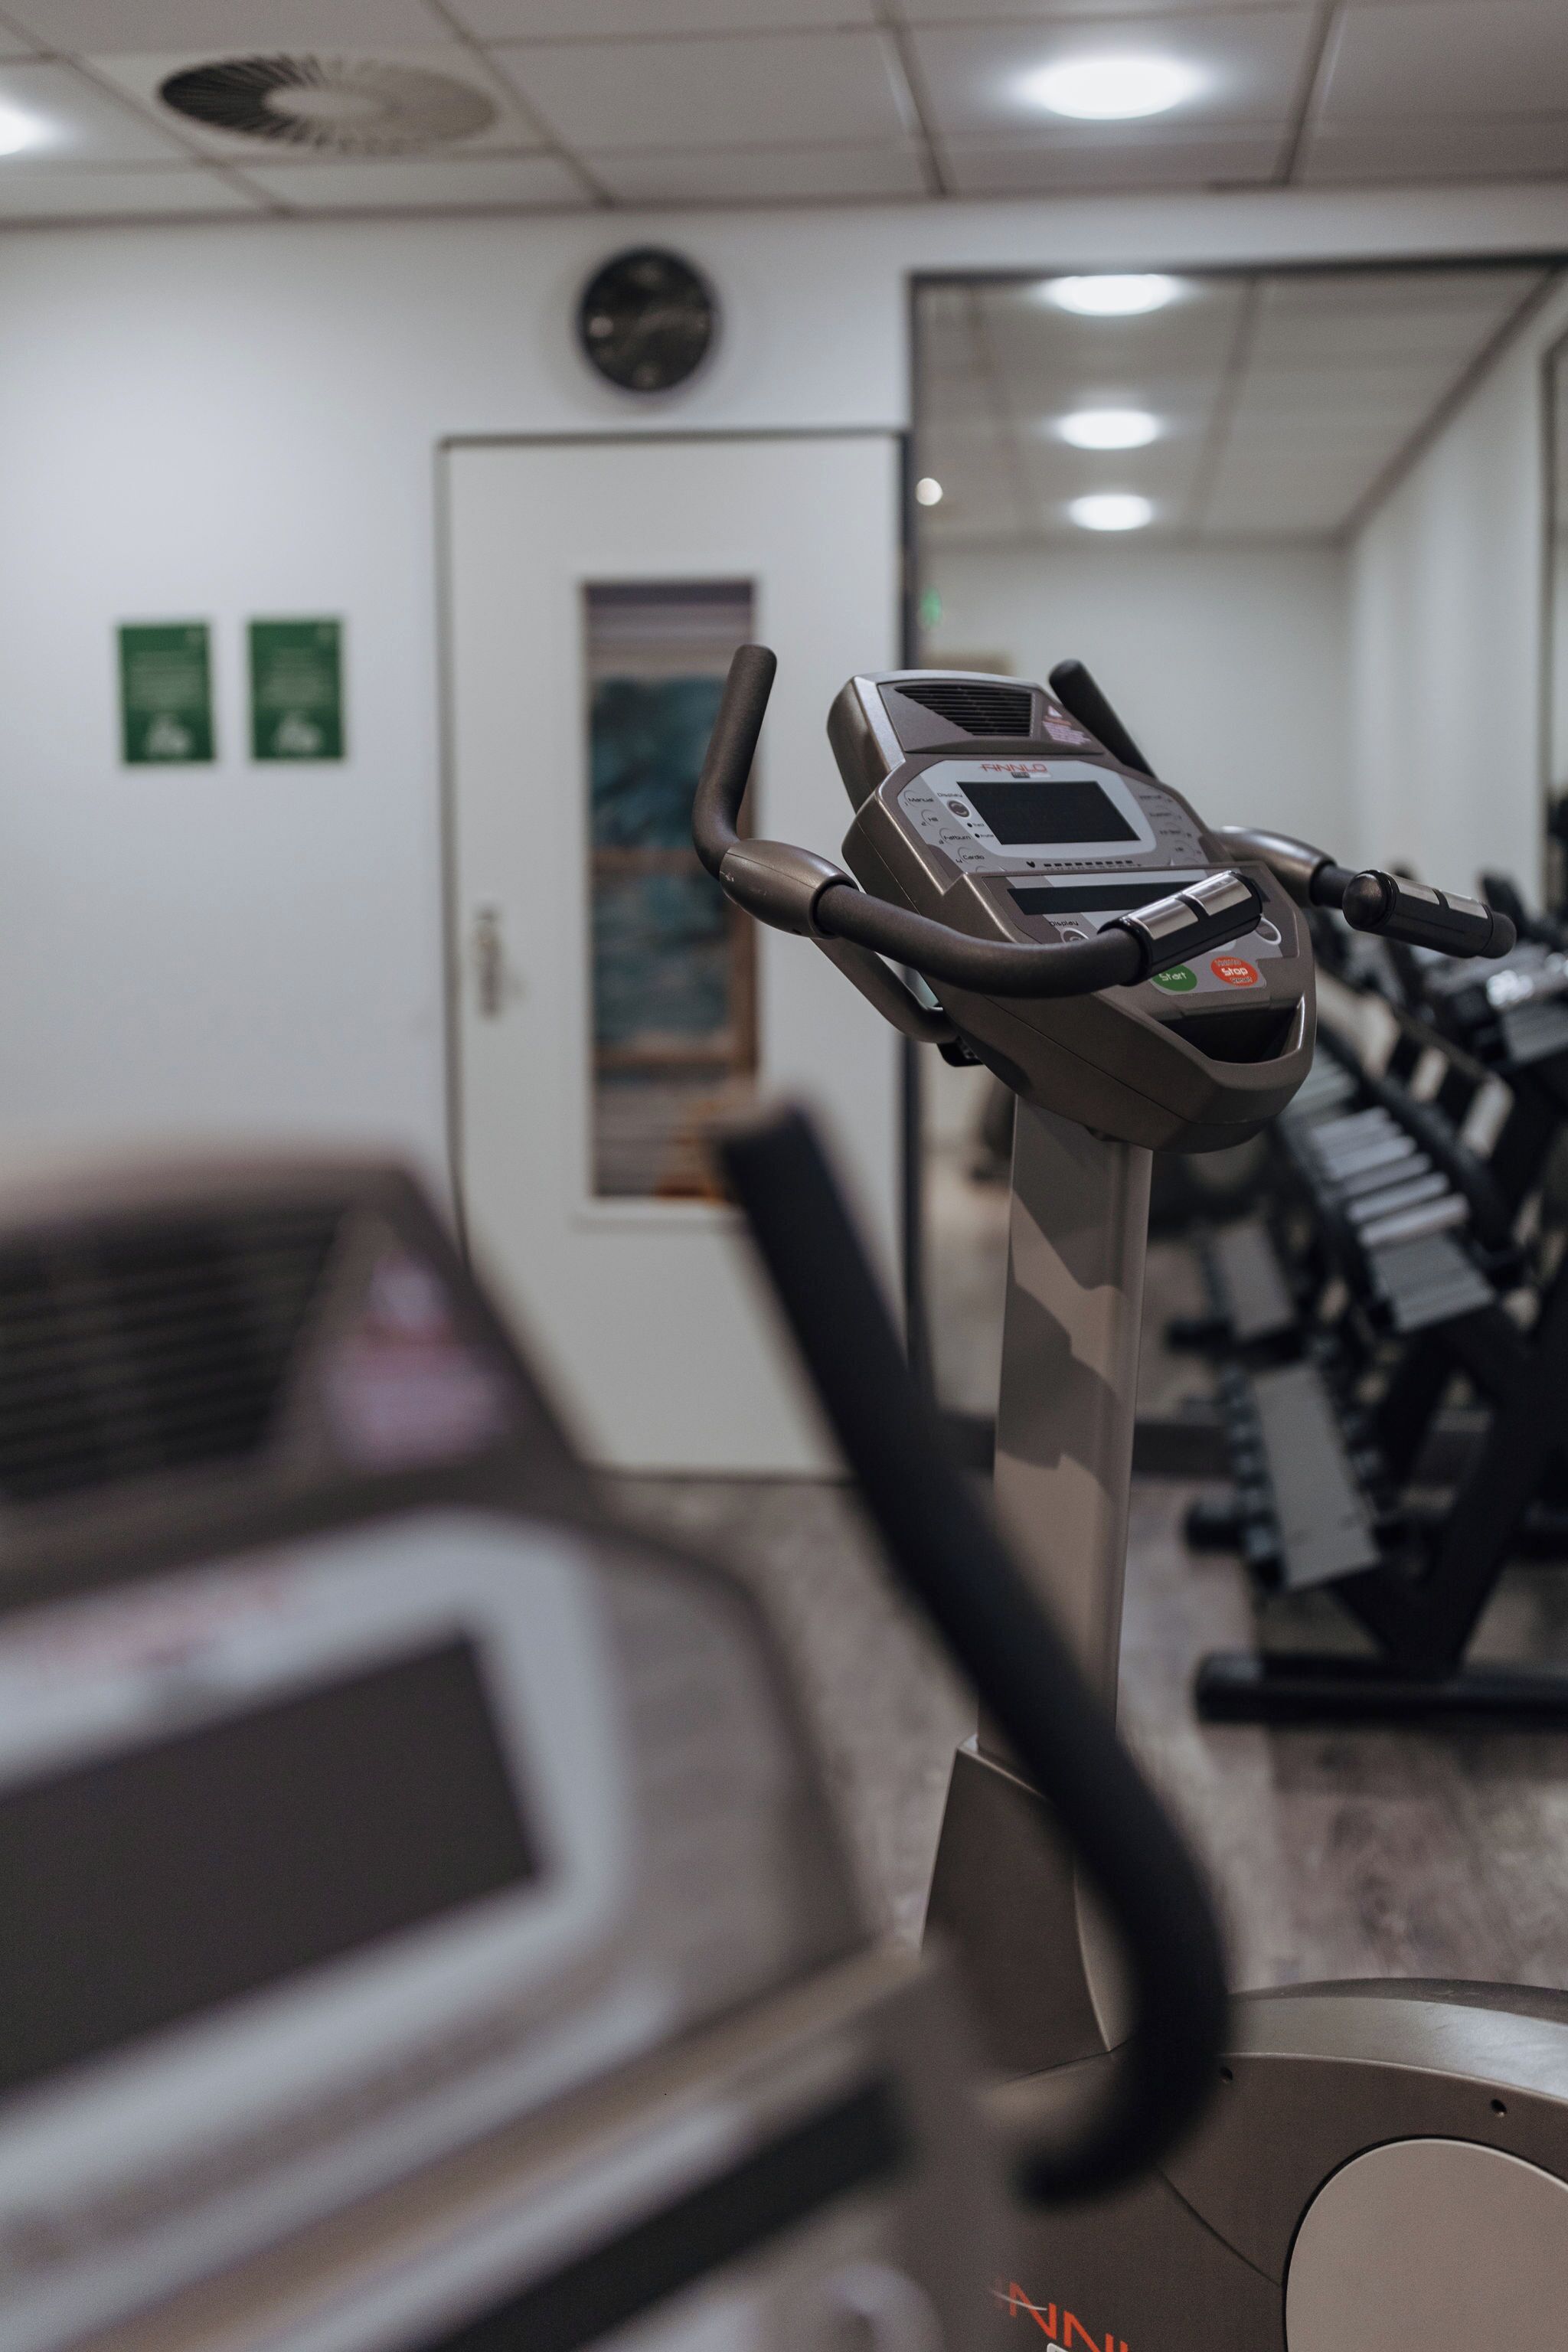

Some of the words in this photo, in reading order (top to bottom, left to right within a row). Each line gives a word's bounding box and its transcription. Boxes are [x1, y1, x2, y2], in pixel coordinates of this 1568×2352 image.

[978, 763, 1047, 773] FINNLO
[1221, 967, 1249, 976] Stop
[1158, 972, 1187, 982] Start
